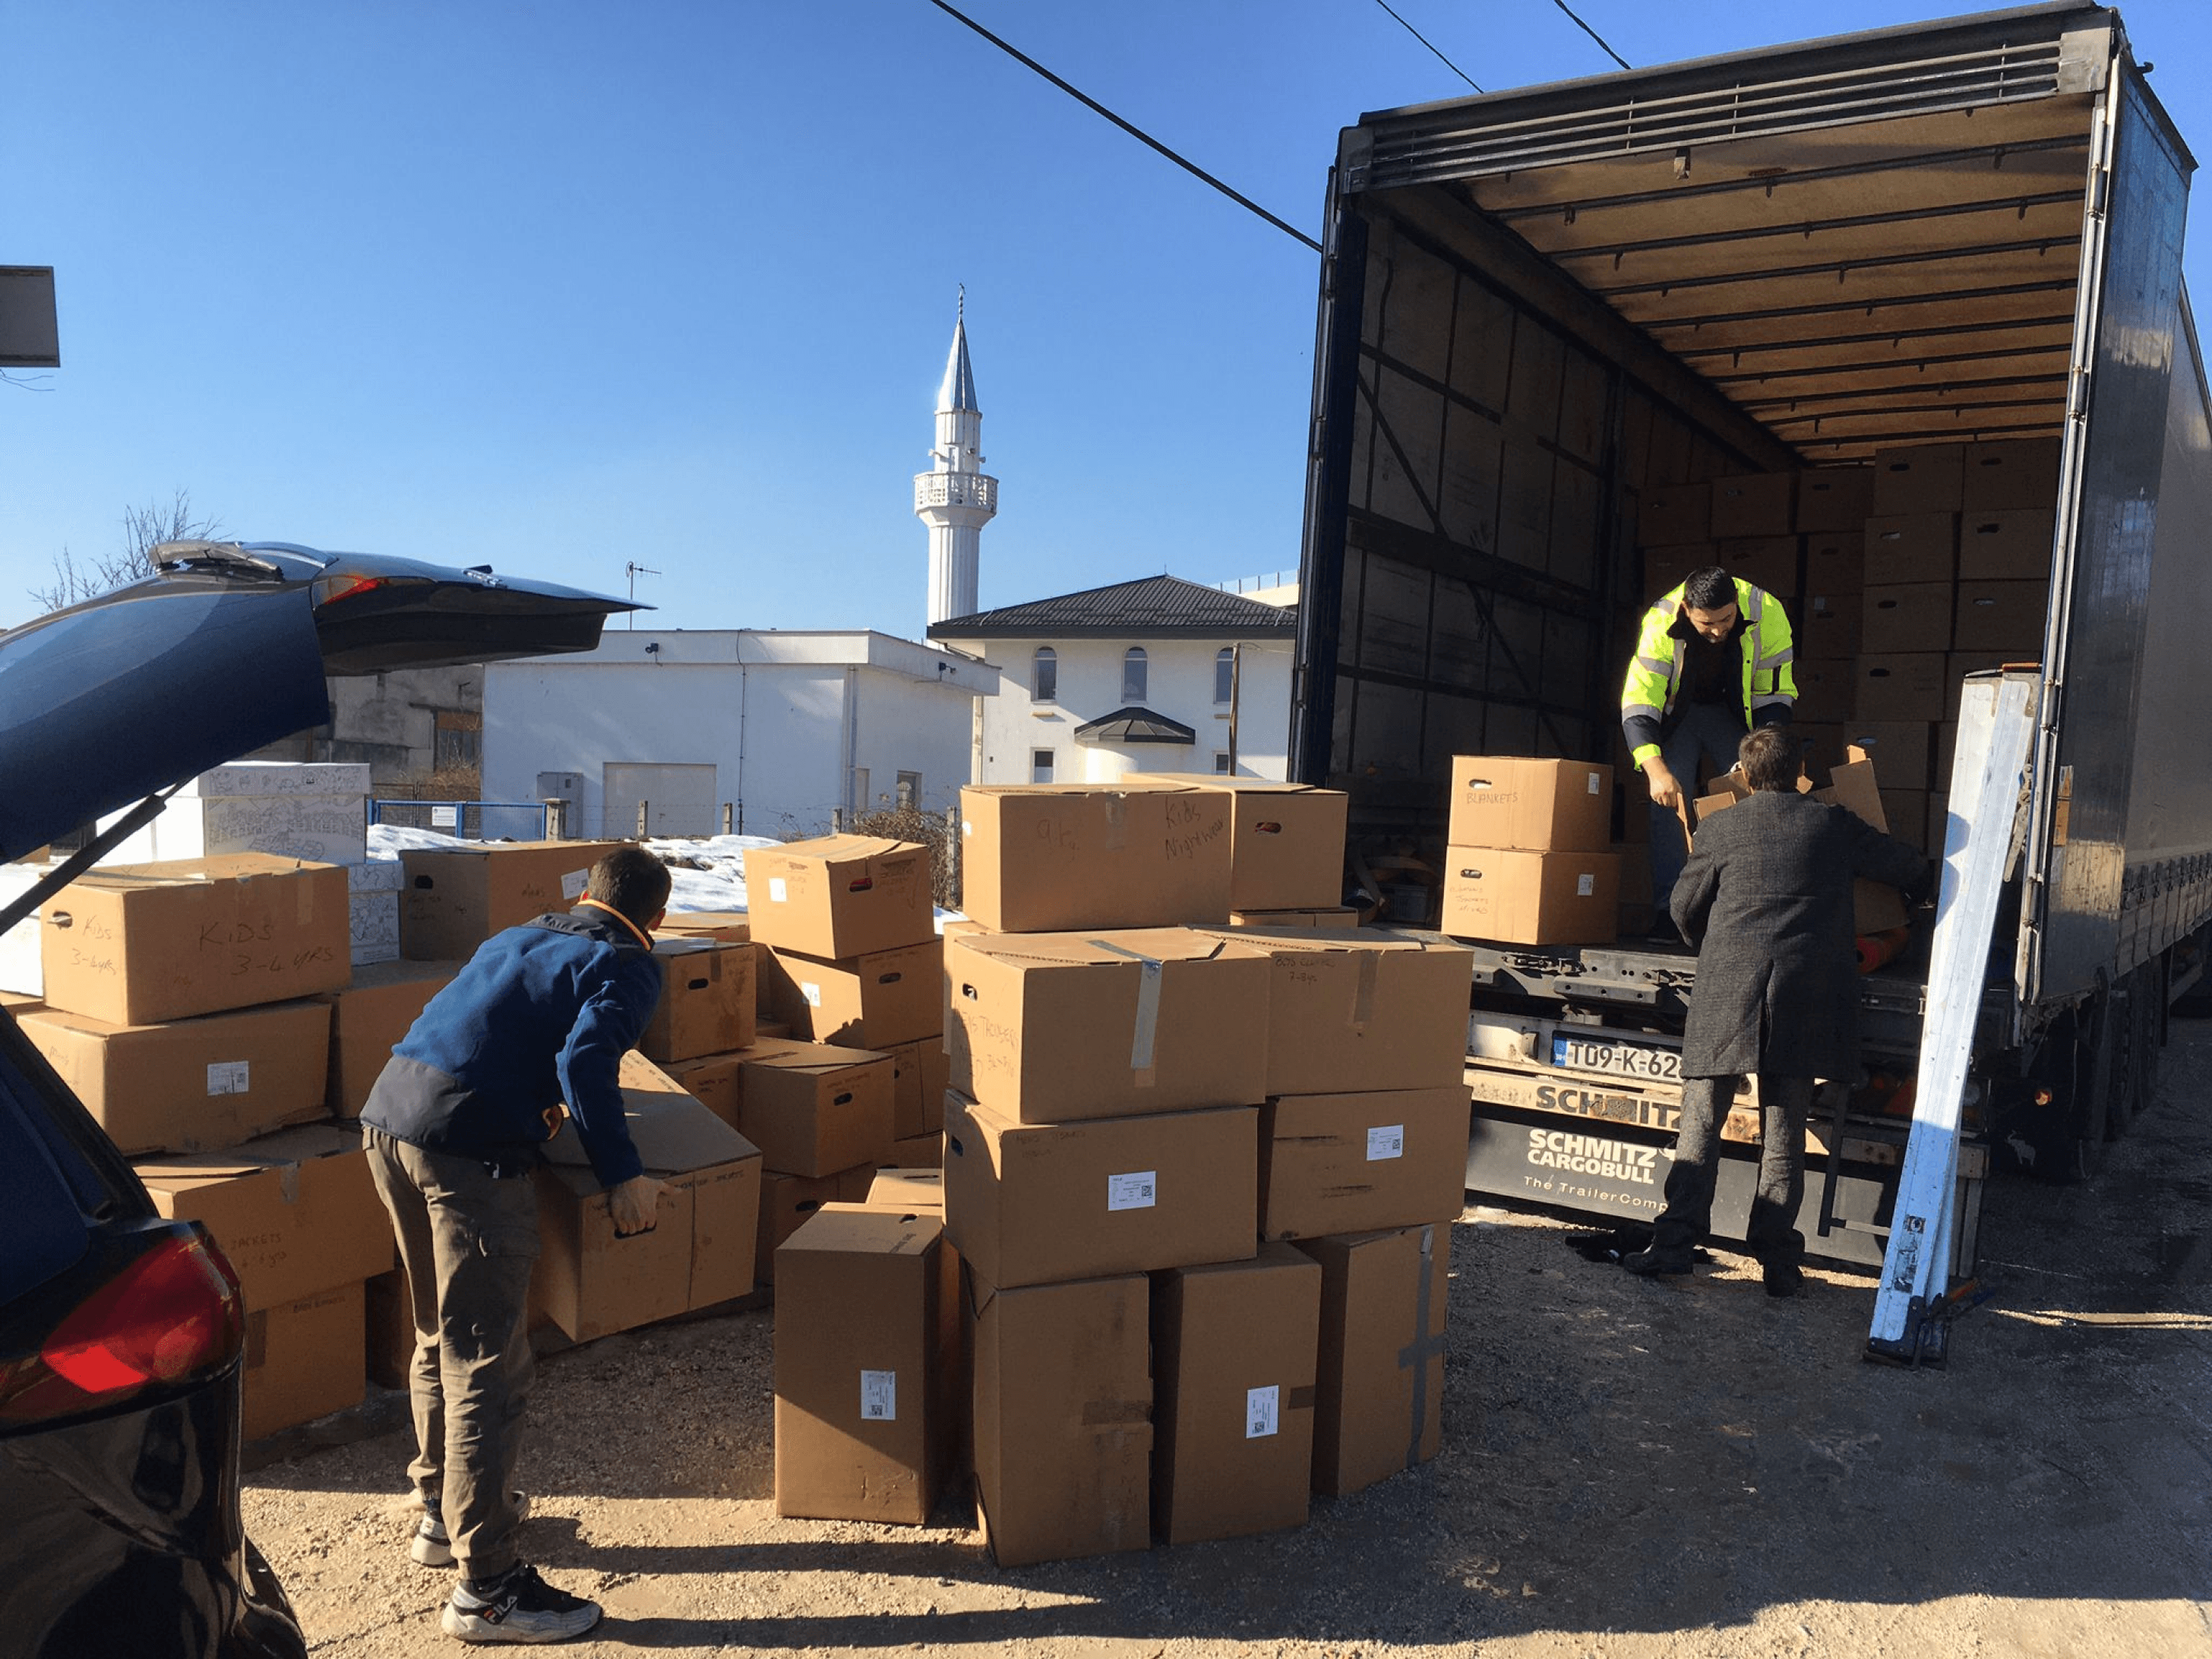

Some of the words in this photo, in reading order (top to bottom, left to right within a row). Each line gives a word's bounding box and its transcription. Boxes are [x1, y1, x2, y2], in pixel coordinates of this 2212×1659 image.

[1466, 792, 1518, 804] BLANKETS
[1569, 1042, 1683, 1079] T09-K-62
[1535, 1085, 1681, 1130] SCHIT
[1529, 1129, 1657, 1168] SCHMITZ
[1524, 1175, 1553, 1191] The
[1528, 1149, 1654, 1185] CARGOBULL
[483, 1595, 518, 1623] FILA
